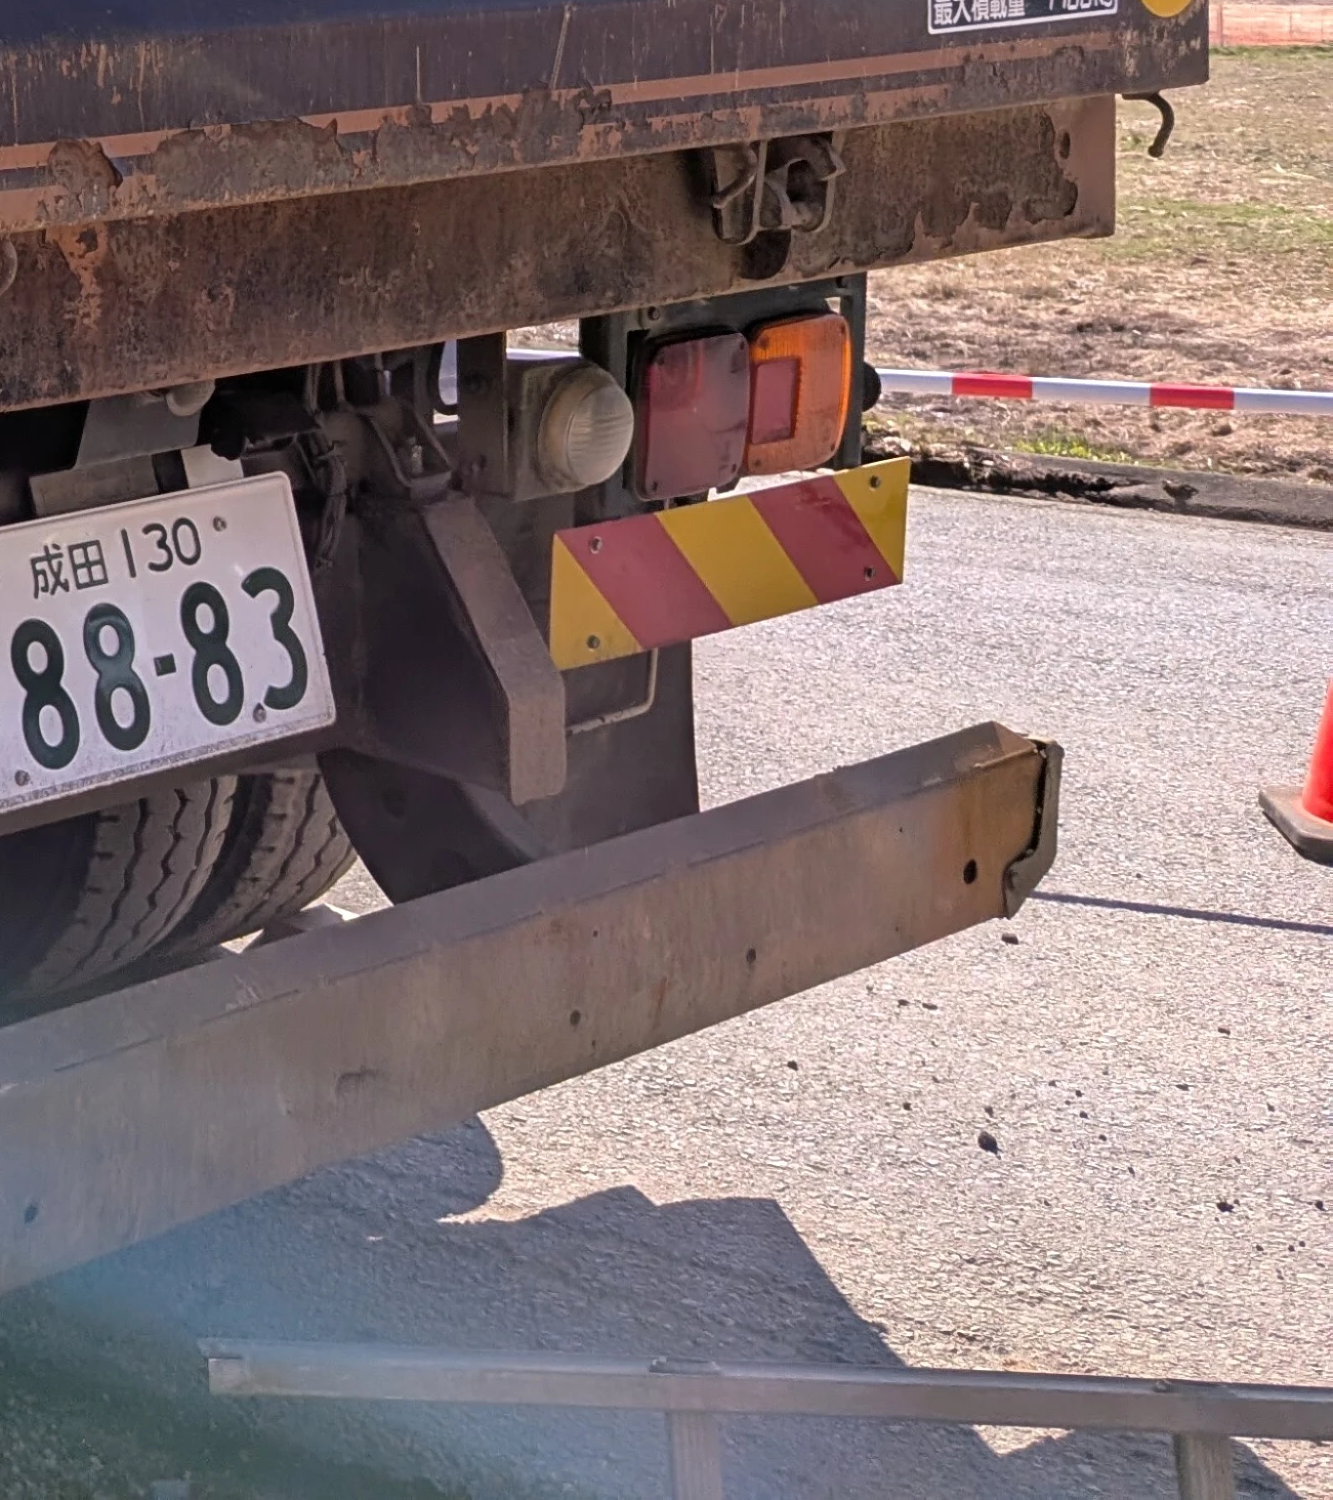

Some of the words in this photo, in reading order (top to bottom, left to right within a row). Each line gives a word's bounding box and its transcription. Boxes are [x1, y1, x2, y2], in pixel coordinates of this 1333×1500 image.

[30, 539, 110, 599] 成田
[120, 517, 202, 578] 130
[10, 566, 308, 770] 88-83
